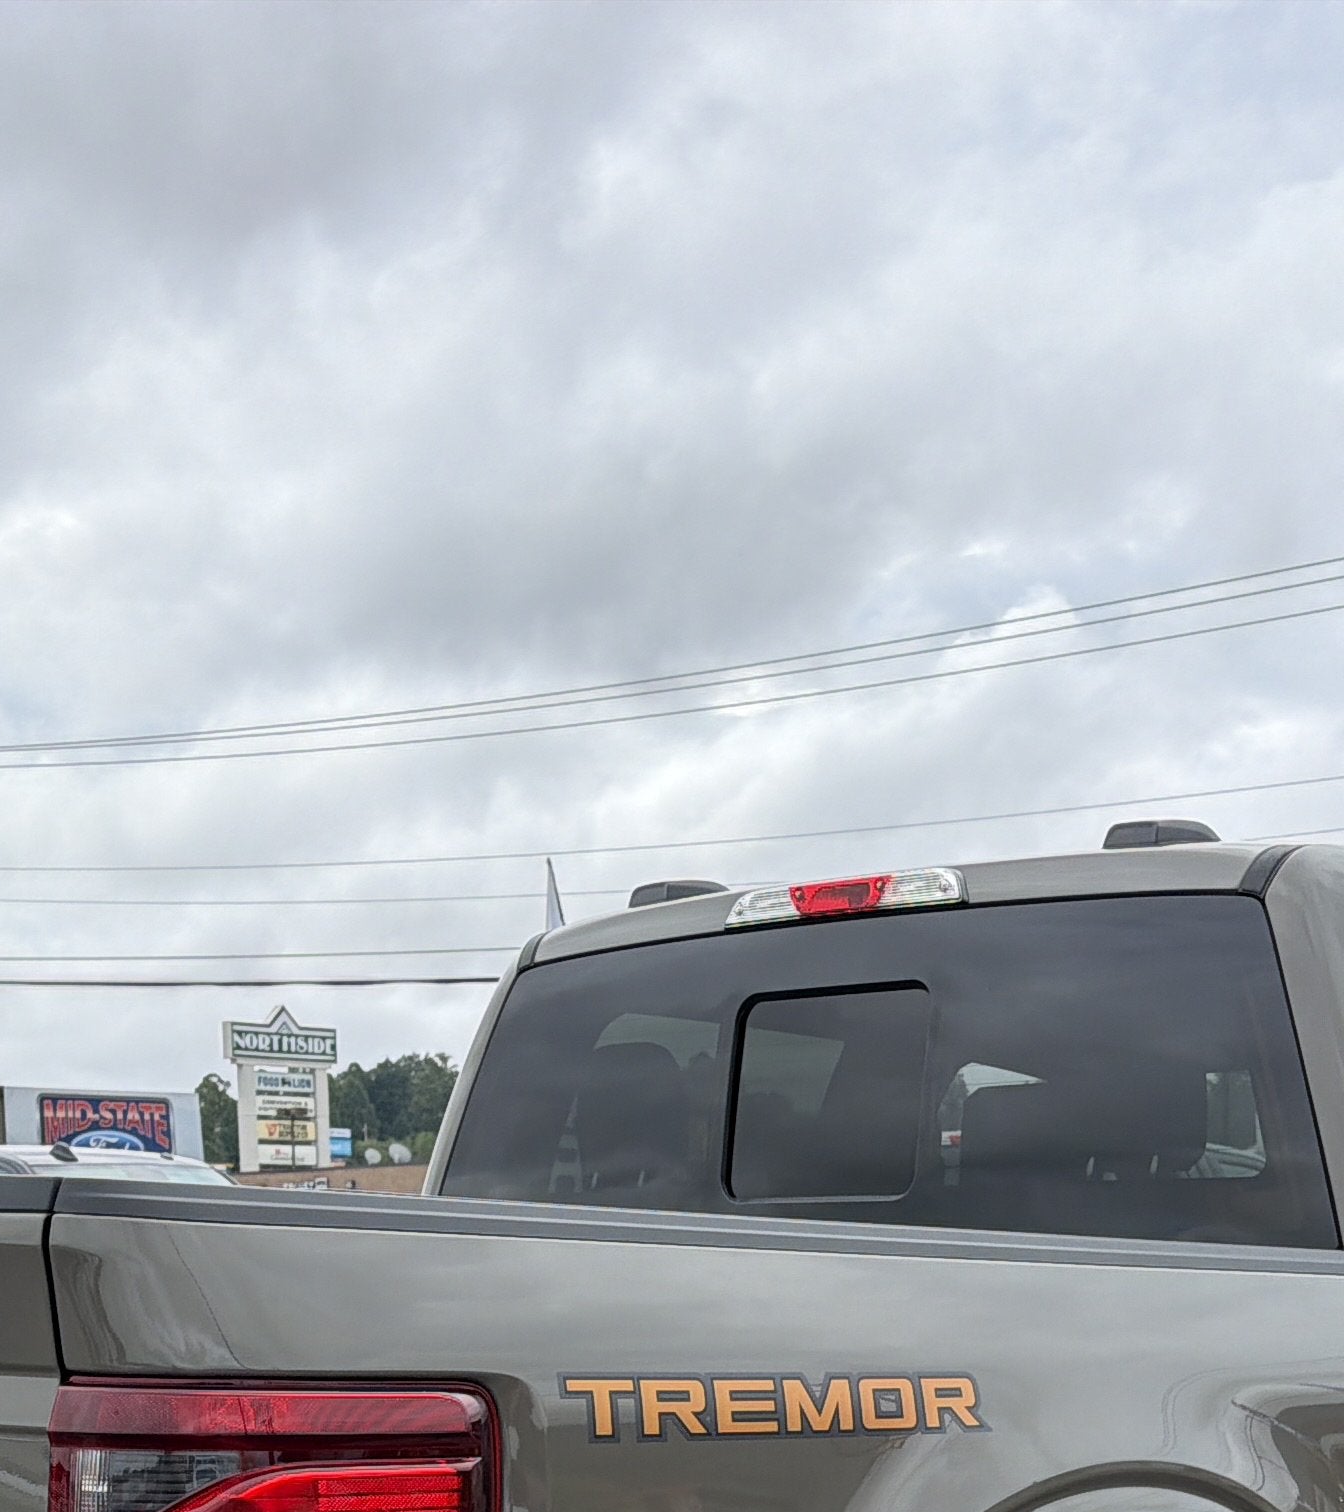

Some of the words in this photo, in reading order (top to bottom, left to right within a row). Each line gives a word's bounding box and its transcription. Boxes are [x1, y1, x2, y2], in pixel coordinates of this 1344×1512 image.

[233, 1031, 336, 1055] NORTHSIDE
[292, 1077, 312, 1089] LION
[43, 1099, 170, 1150] MID-STATE
[560, 1373, 991, 1443] TREMOR
